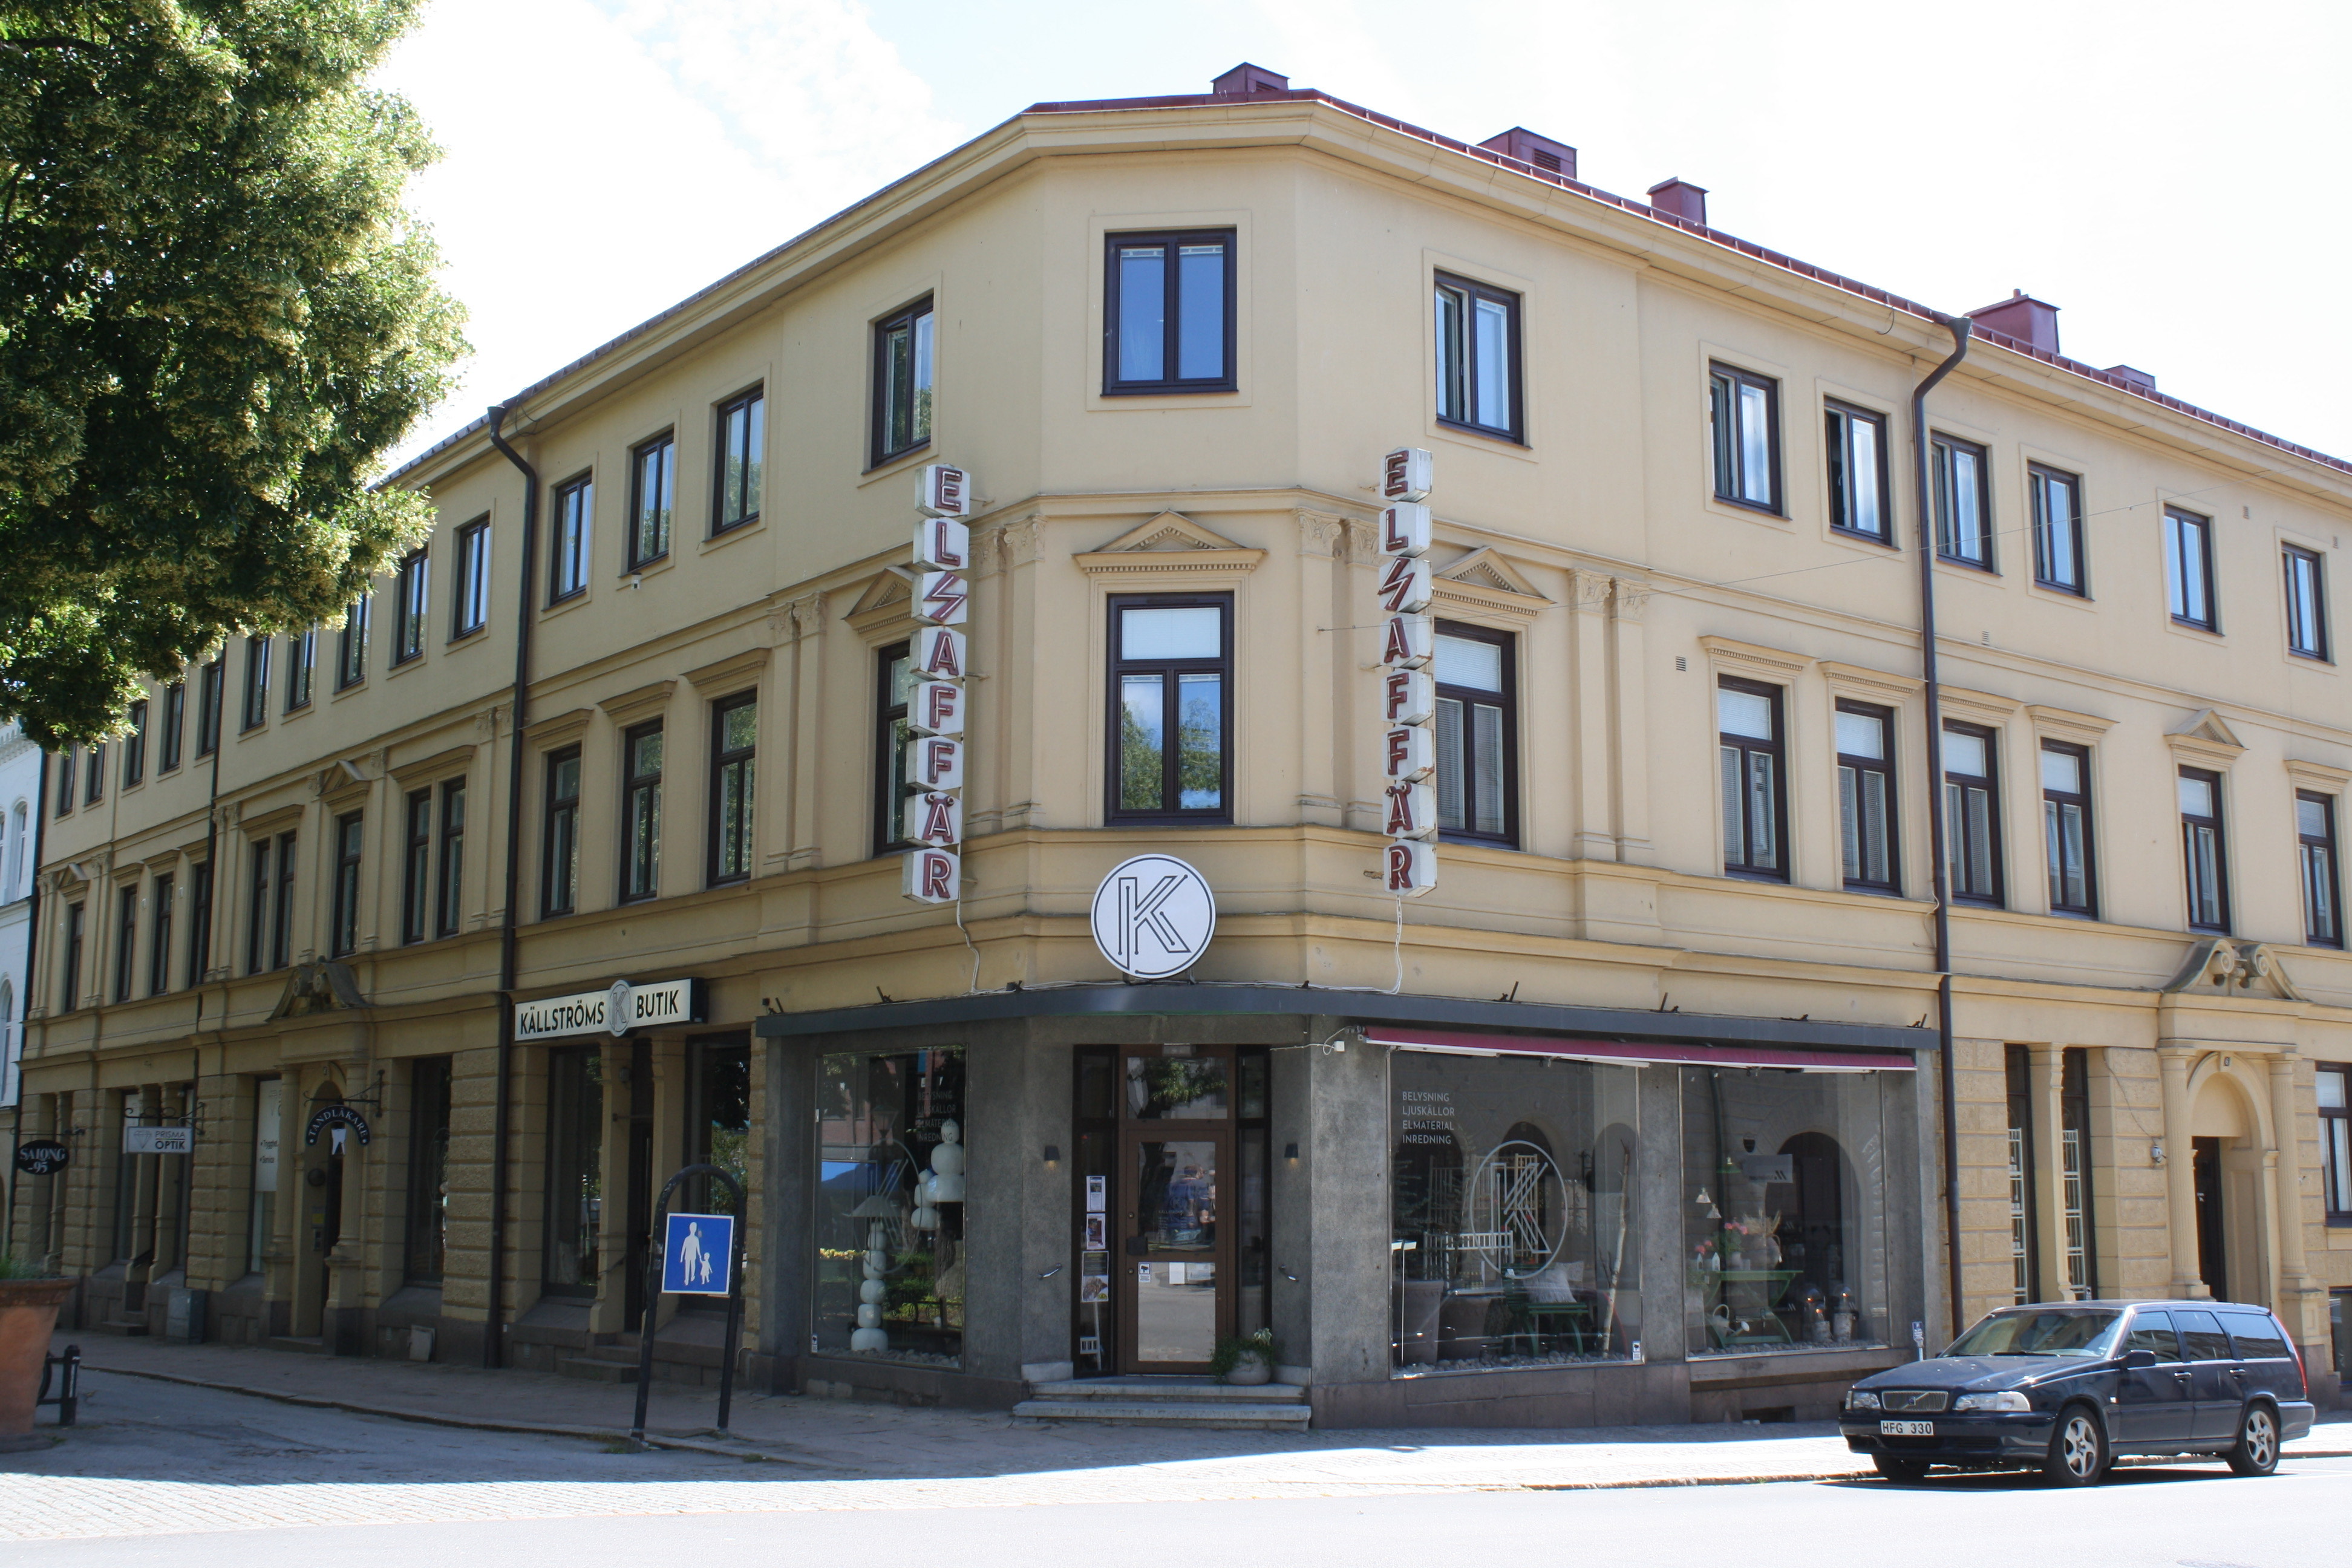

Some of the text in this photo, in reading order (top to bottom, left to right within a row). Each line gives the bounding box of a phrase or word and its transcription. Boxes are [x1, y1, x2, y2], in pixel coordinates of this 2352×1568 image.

[520, 1000, 604, 1034] KÄLLSTRÖMS
[636, 990, 679, 1019] BUTIK
[1402, 1091, 1449, 1102] BELYSNING
[1402, 1105, 1455, 1116] LJUSKÄLLOR
[309, 1108, 368, 1137] TANDLÄKARE
[1403, 1120, 1454, 1131] ELMATERIAL
[917, 1132, 953, 1142] INREDNING
[1403, 1134, 1451, 1145] INREDNING
[155, 1140, 185, 1149] OPTIK
[1883, 1422, 1932, 1434] HFG 330
